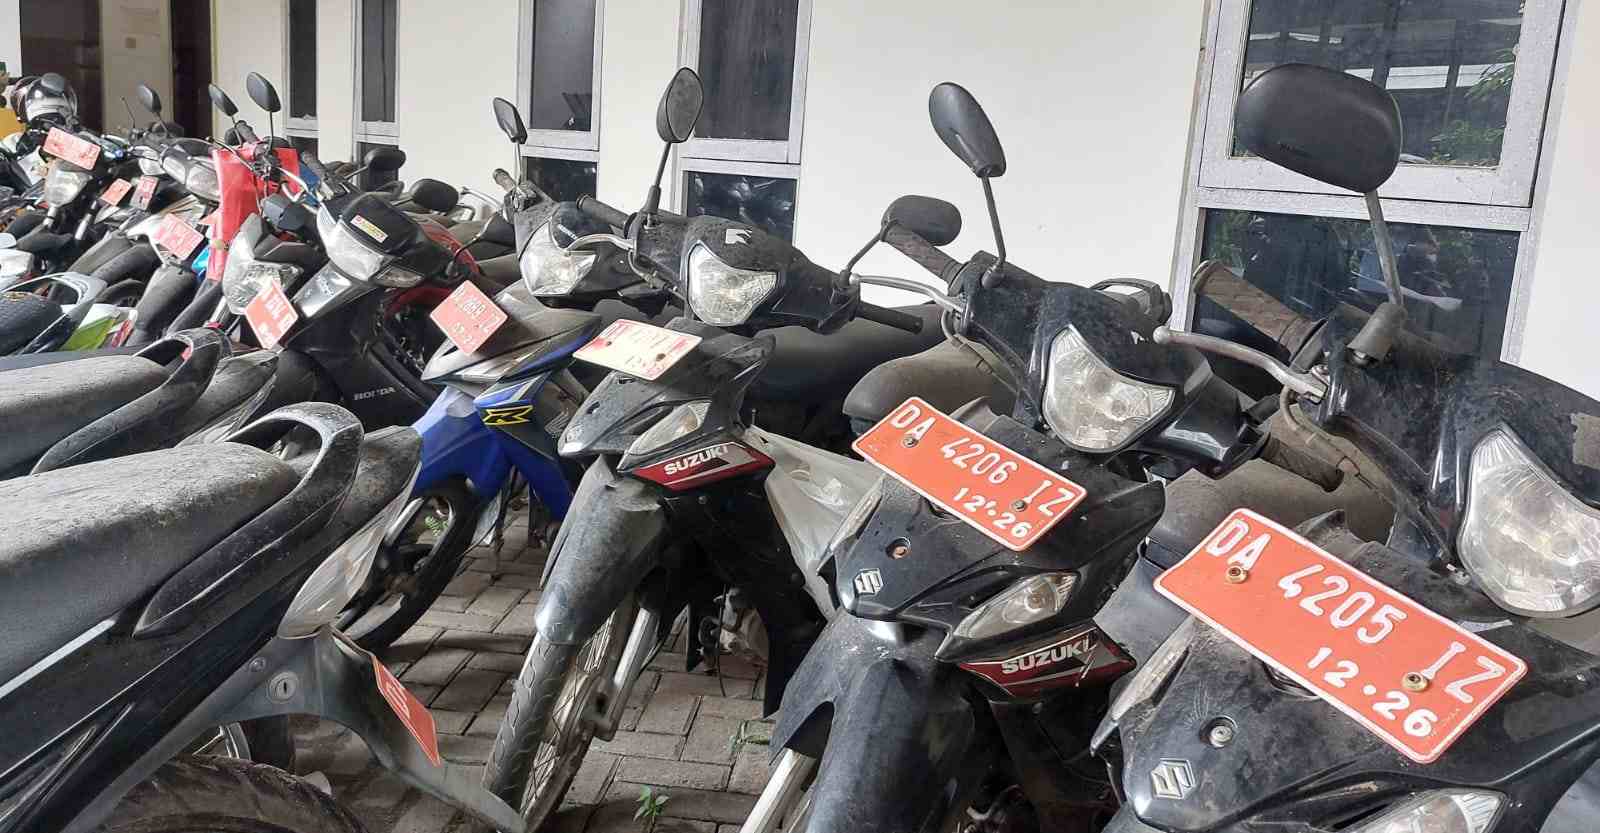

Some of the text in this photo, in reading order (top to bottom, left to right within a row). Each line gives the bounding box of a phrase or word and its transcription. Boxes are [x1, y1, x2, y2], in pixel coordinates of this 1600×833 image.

[663, 445, 729, 476] SUZUKI
[890, 405, 1076, 516] DA 4206 IZ
[1204, 518, 1506, 704] DA 4205 IZ
[1001, 635, 1091, 675] SUZUKI
